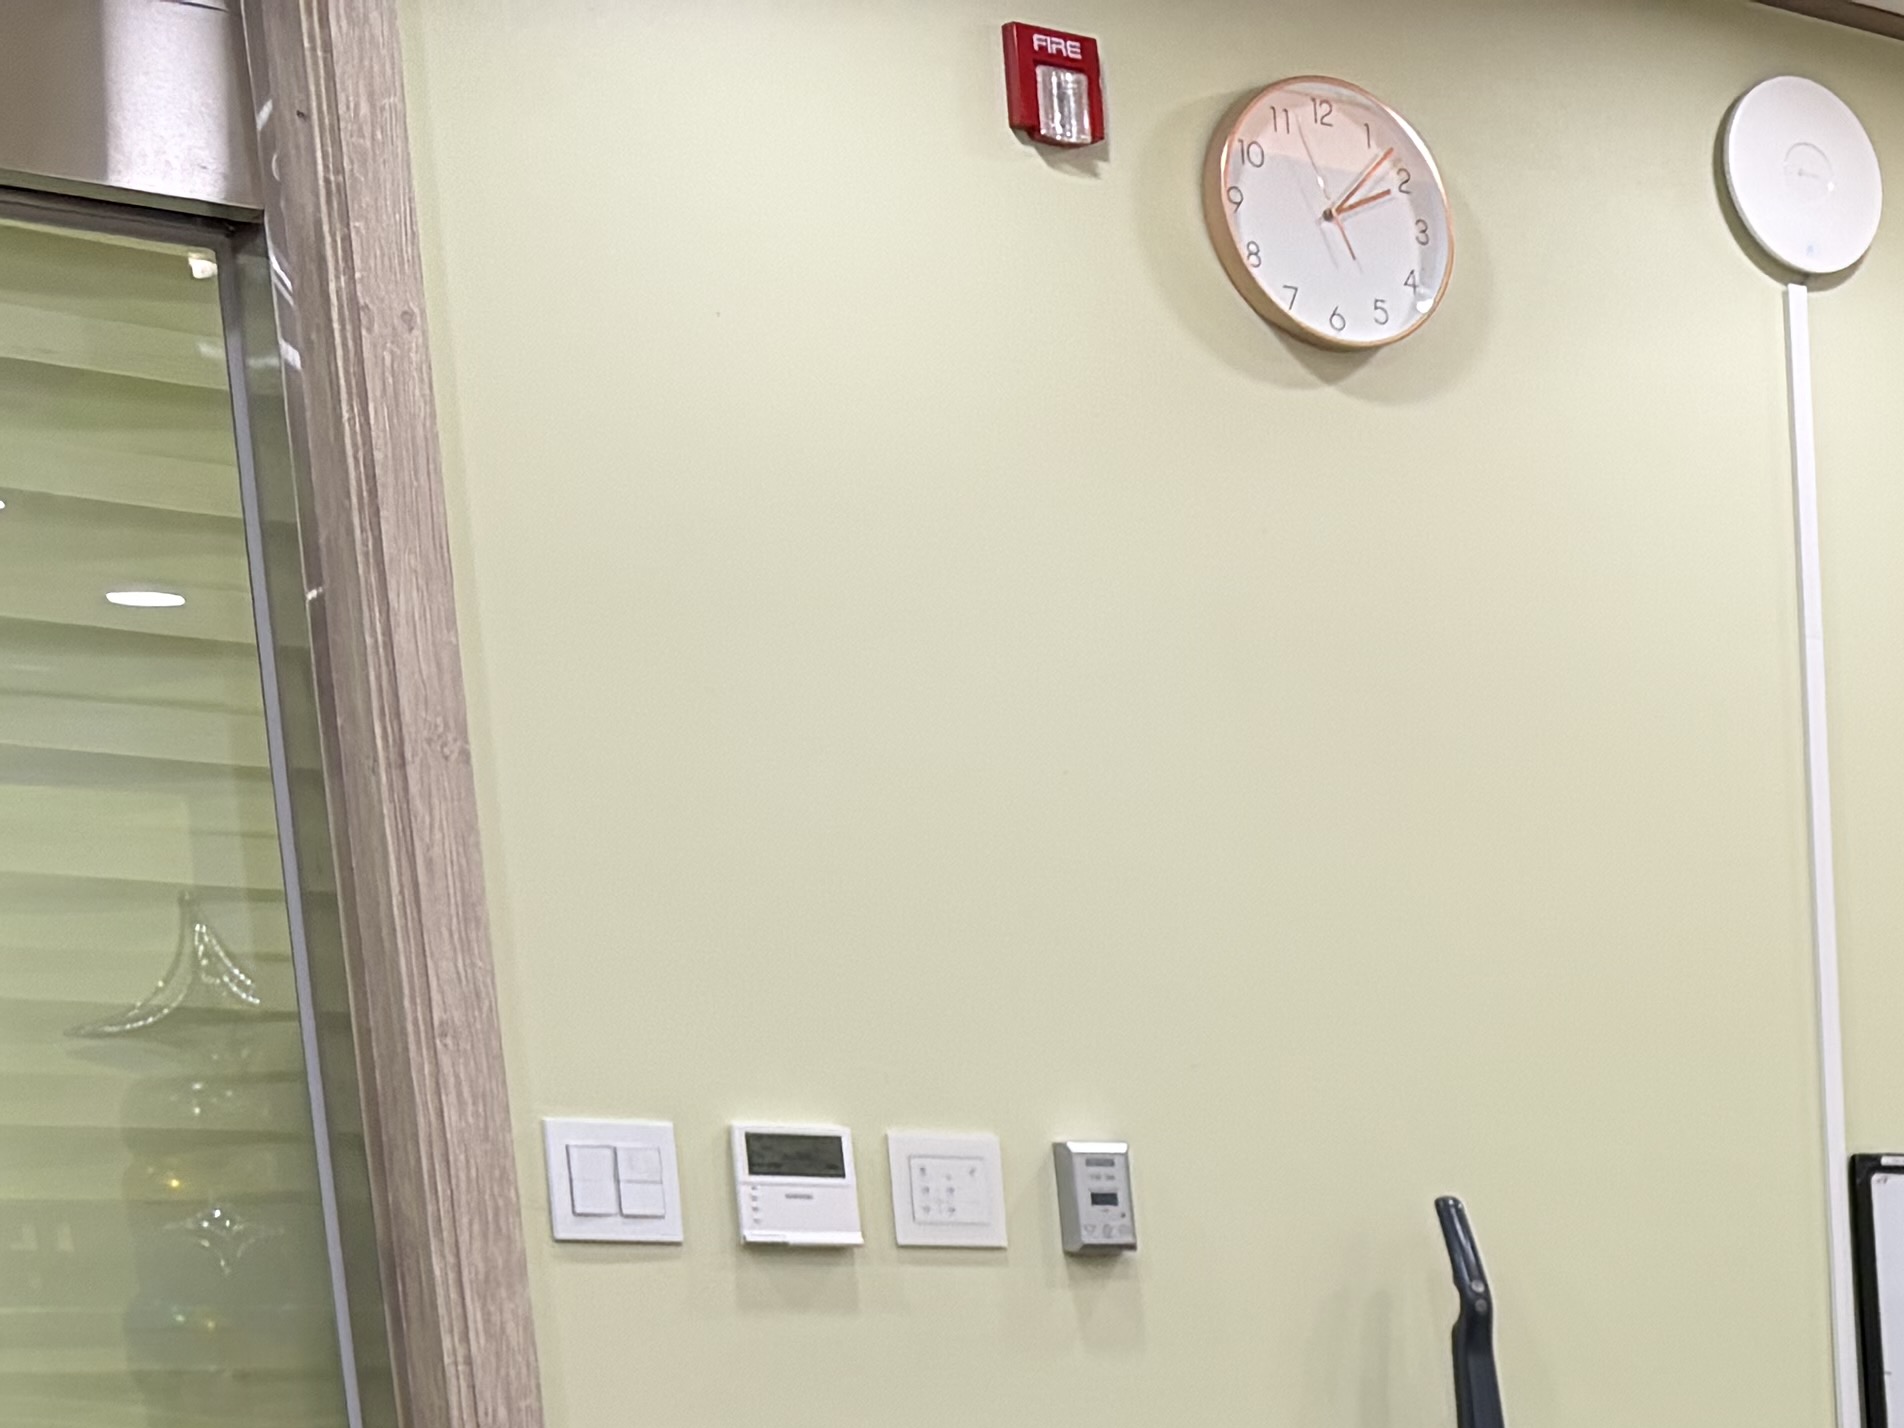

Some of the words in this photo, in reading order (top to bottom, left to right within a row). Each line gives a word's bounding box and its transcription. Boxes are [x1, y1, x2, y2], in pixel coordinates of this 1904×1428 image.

[1033, 34, 1082, 60] FIRE
[1270, 106, 1291, 134] 11
[1311, 98, 1334, 127] 12
[1238, 139, 1265, 168] 10
[1398, 168, 1412, 194] 2
[1226, 186, 1243, 212] 9
[1415, 218, 1429, 246] 3
[1245, 240, 1262, 267] 8
[1403, 269, 1419, 295] 4
[1282, 284, 1298, 311] 7
[1329, 305, 1346, 331] 6
[1373, 298, 1389, 325] 5
